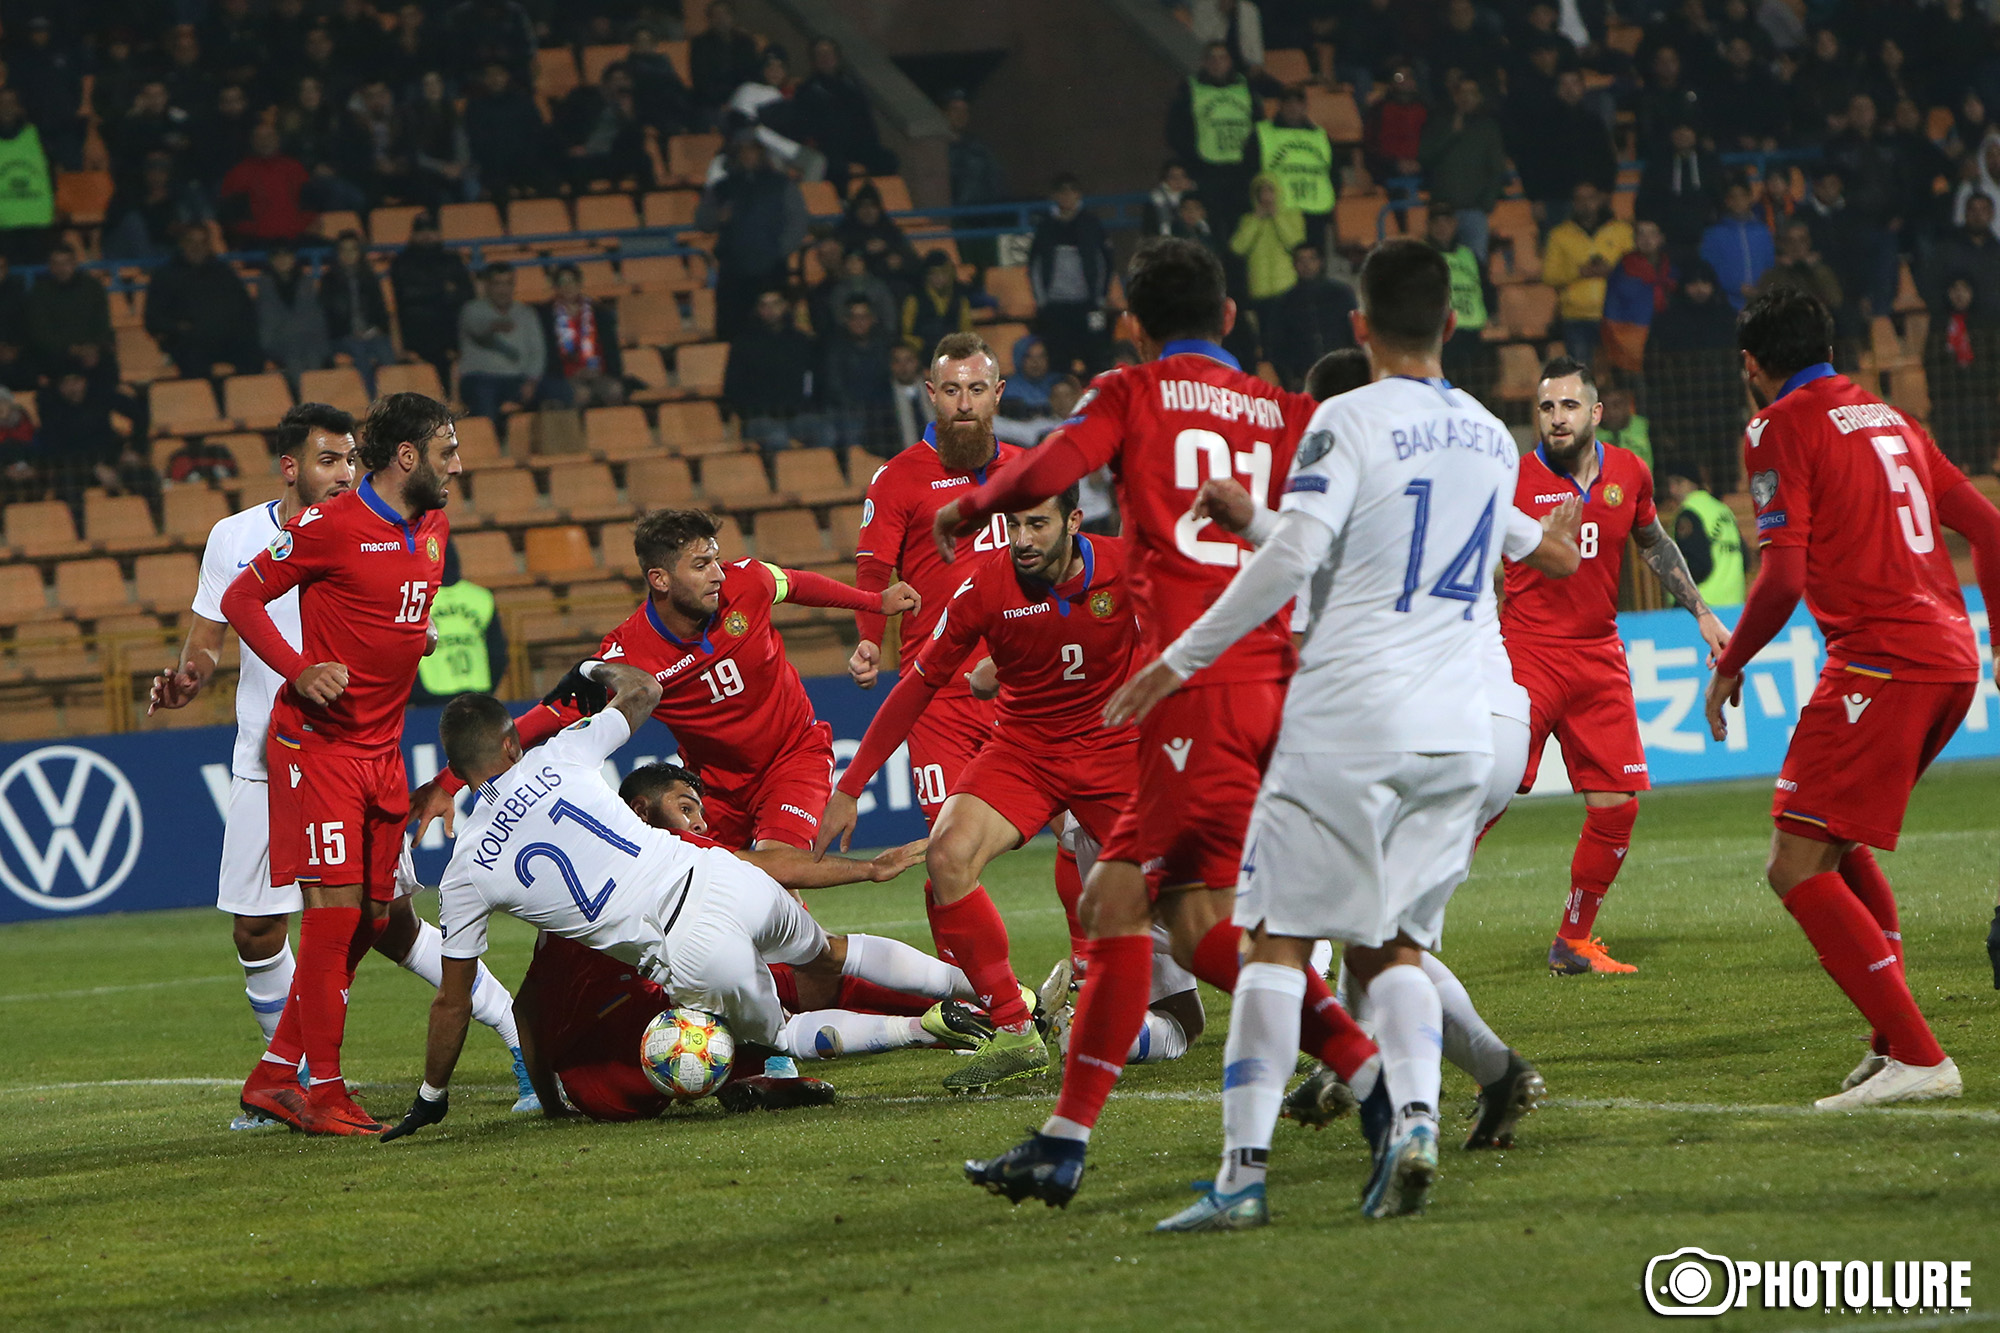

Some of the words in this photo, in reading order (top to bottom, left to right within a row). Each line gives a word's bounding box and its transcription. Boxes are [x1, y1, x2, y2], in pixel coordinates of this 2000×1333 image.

[1392, 416, 1516, 469] BAKASETAS
[930, 476, 970, 490] macron
[1870, 435, 1934, 554] 5
[360, 541, 400, 552] macron
[973, 512, 1010, 552] 20
[1394, 477, 1499, 621] 14
[1580, 522, 1599, 559] 8
[394, 581, 428, 623] 15
[1003, 602, 1051, 619] macron
[655, 653, 696, 682] macron
[700, 658, 745, 704] 19
[1061, 643, 1086, 681] 2
[913, 763, 947, 805] 20
[473, 766, 562, 871] KOURBELIS
[781, 803, 818, 827] macron
[305, 821, 346, 866] 15
[514, 797, 642, 924] 21
